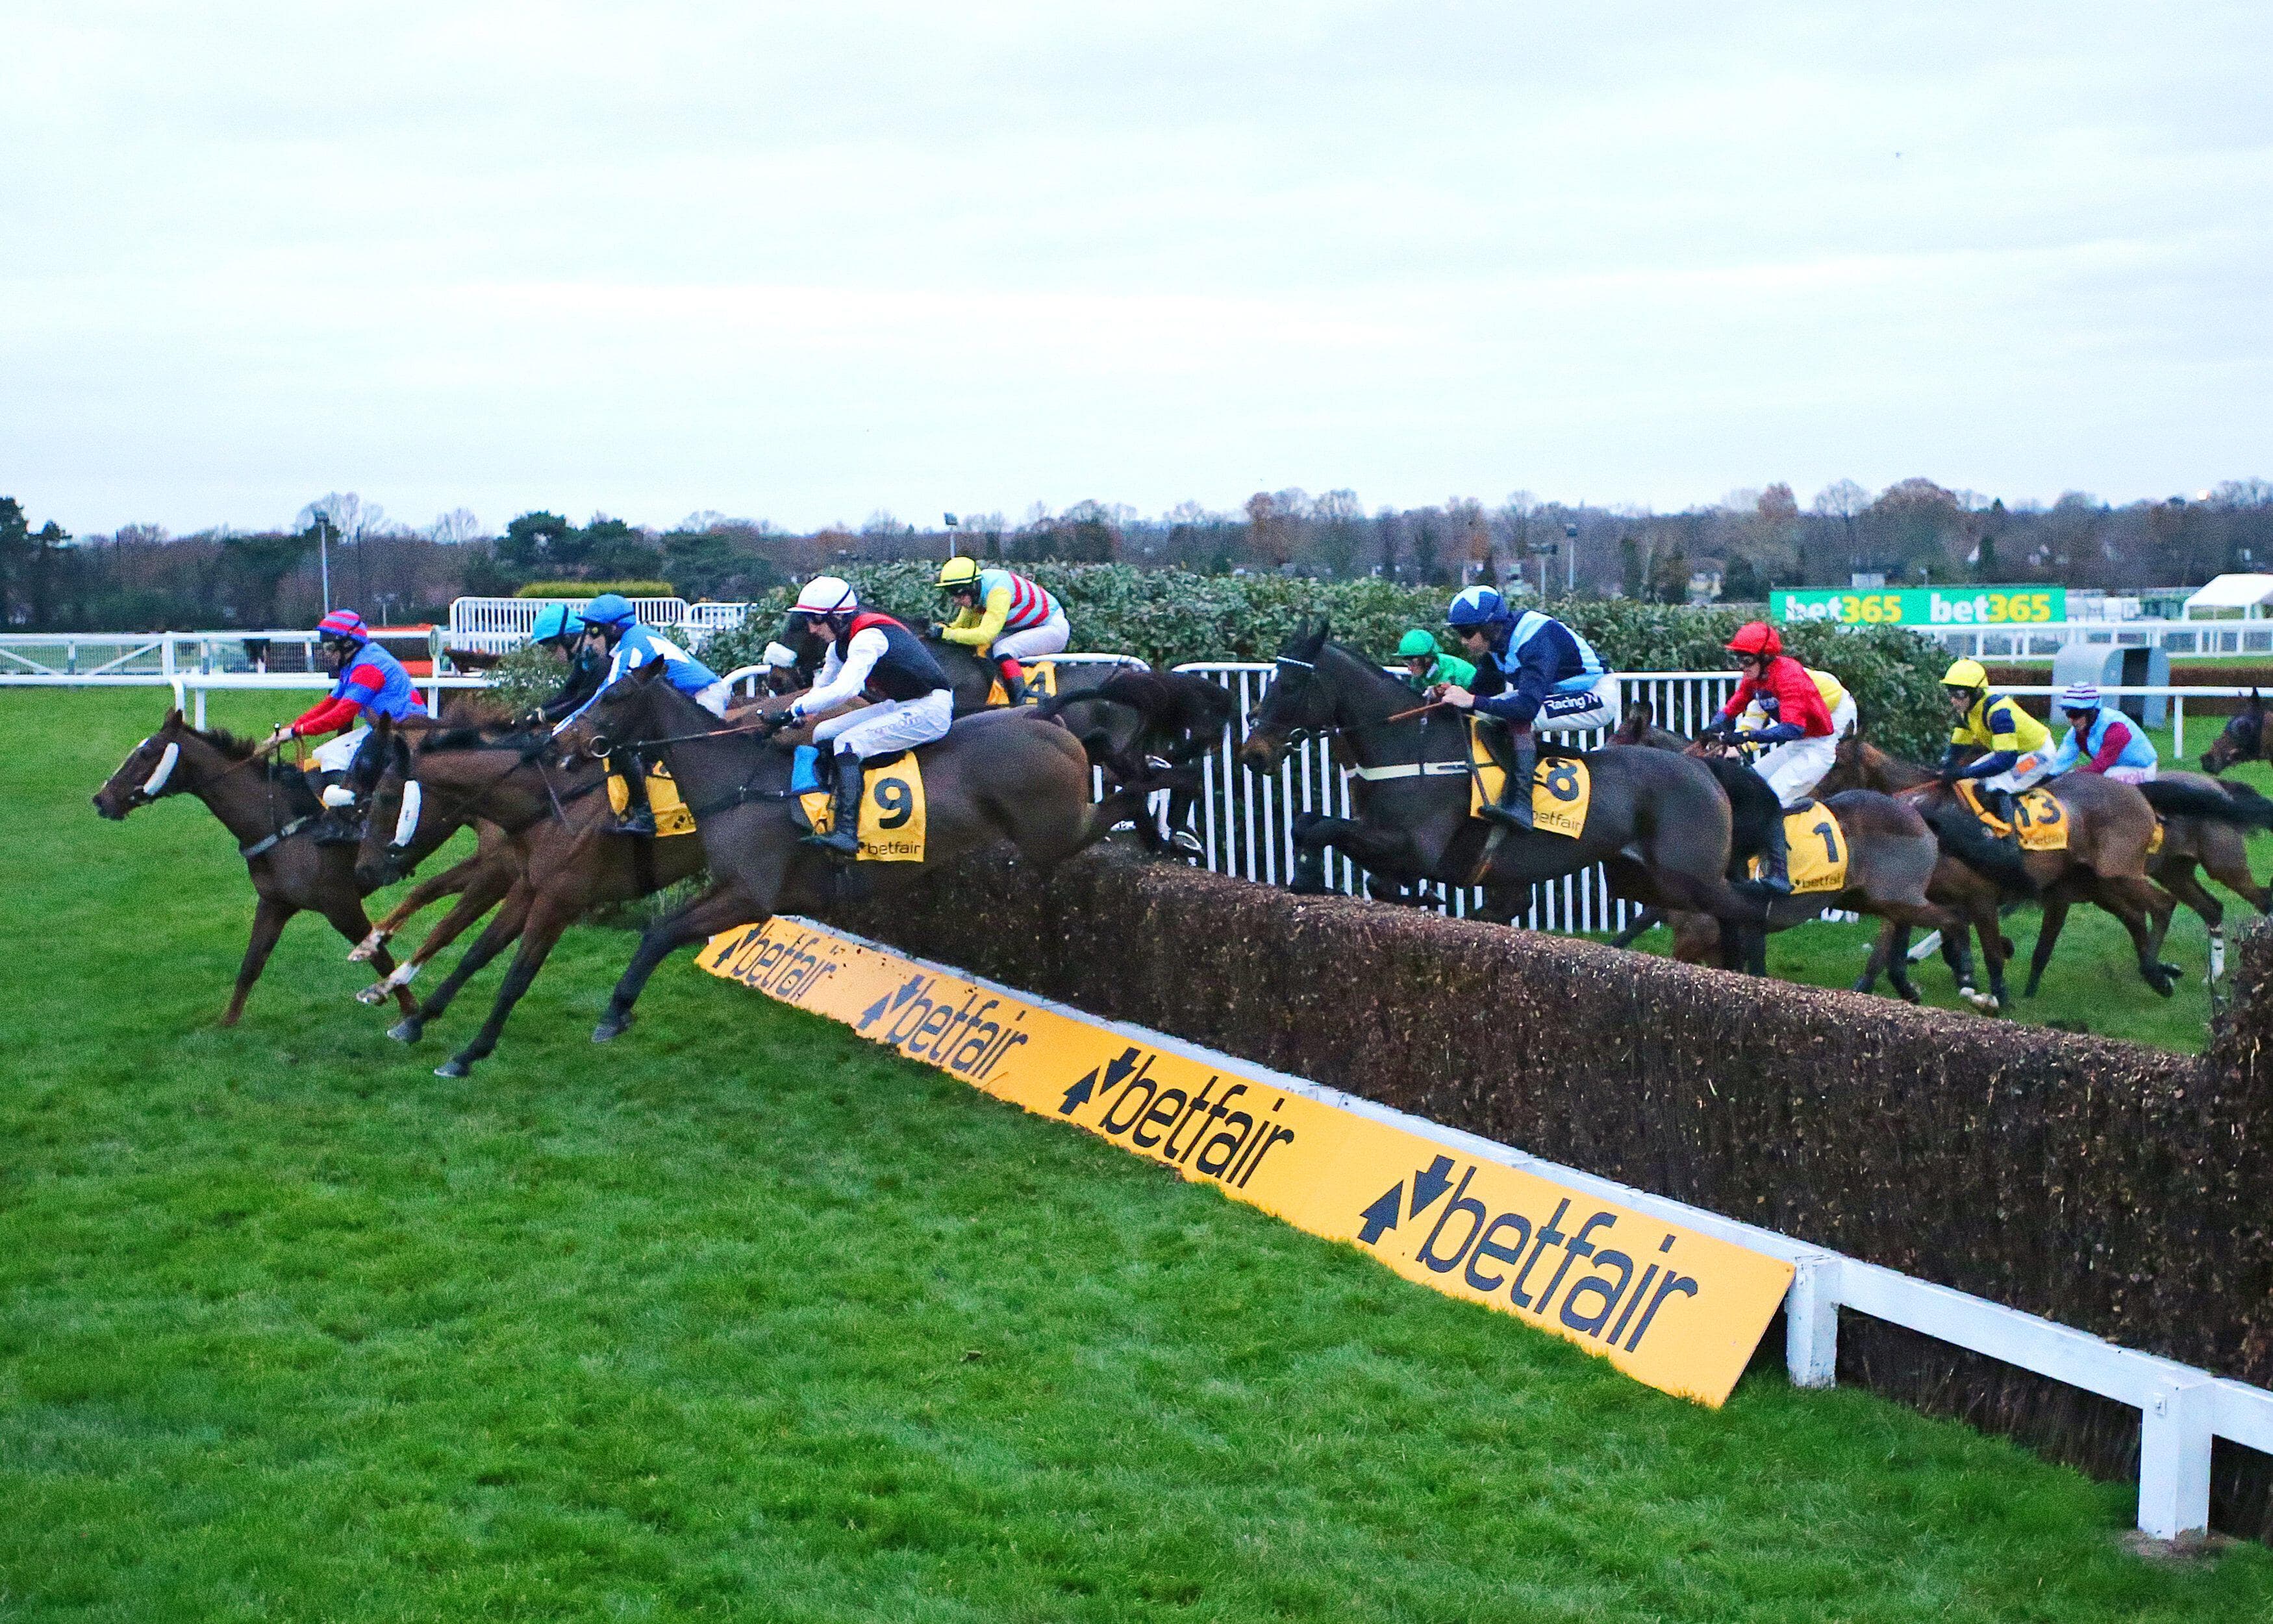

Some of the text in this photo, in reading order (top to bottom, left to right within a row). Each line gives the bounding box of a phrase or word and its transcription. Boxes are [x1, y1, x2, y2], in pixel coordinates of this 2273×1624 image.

[1785, 593, 2052, 623] bet365 bet365
[1544, 696, 1586, 710] Racing
[874, 777, 913, 829] 9
[2016, 798, 2061, 827] 13
[868, 842, 921, 855] betfair
[1813, 822, 1839, 863] 1
[1802, 873, 1844, 888] betfai
[731, 923, 837, 1003] betfair
[887, 979, 1029, 1080] betfair
[1098, 1055, 1294, 1189] betfair
[1415, 1166, 1698, 1353] betfair
